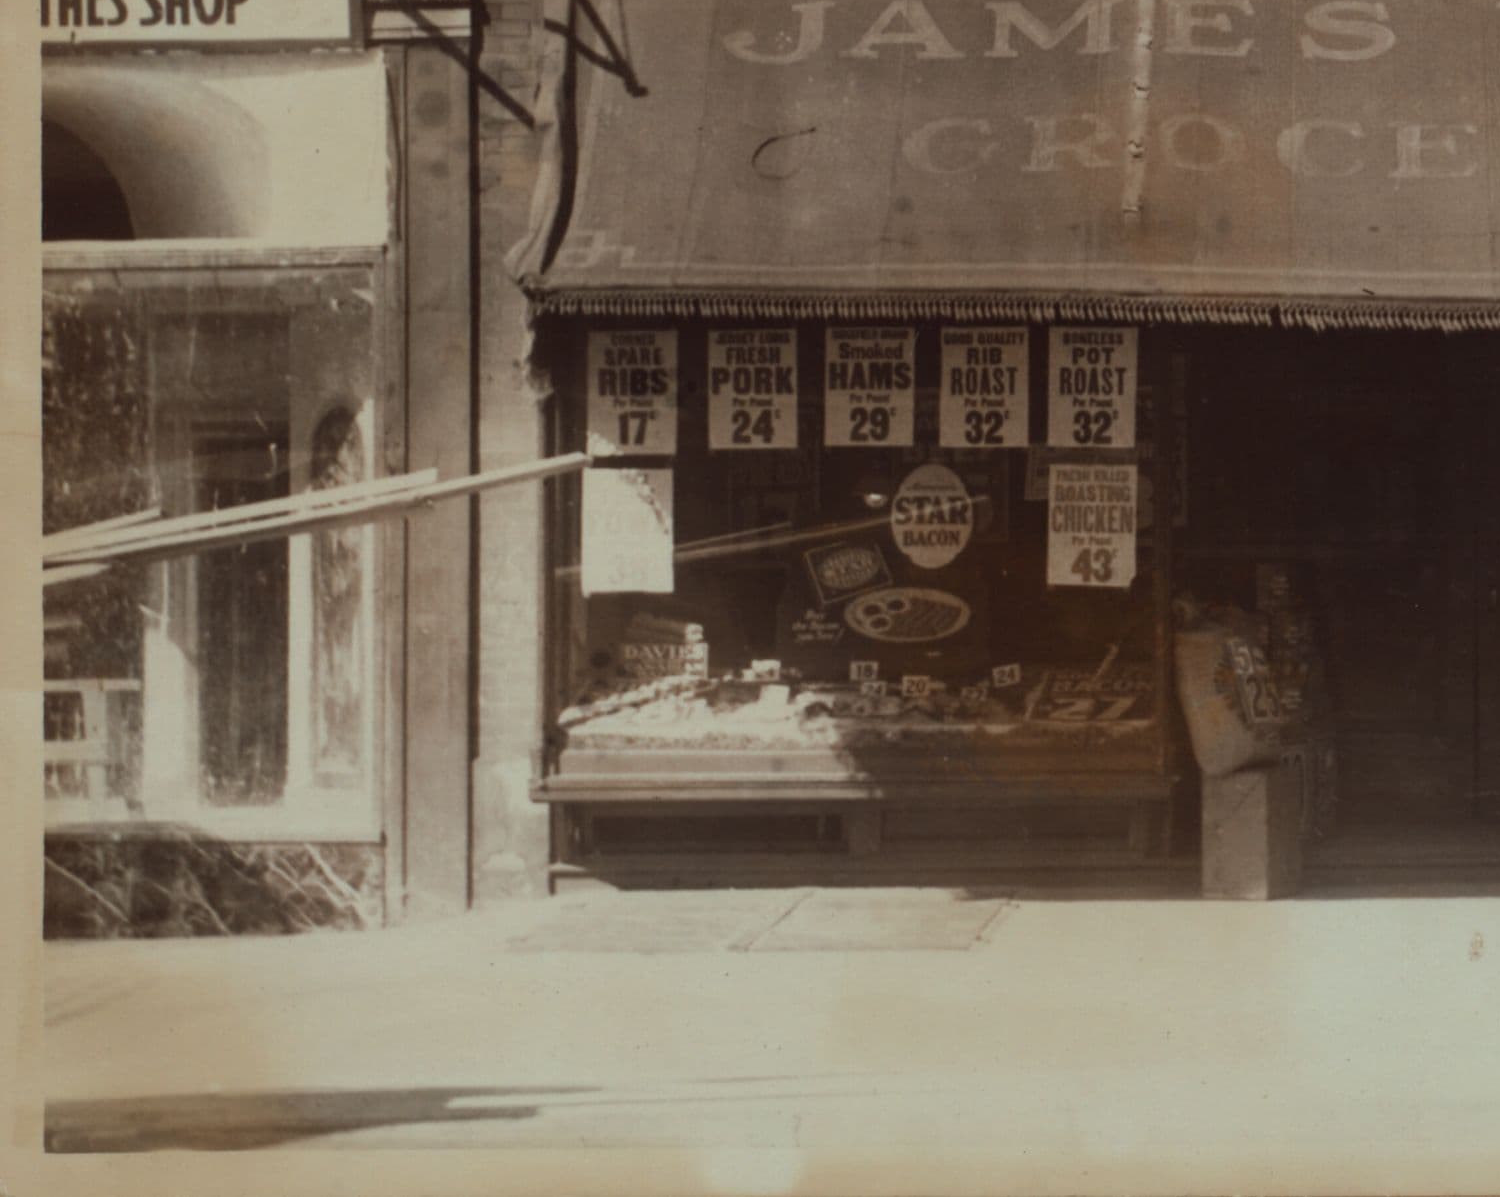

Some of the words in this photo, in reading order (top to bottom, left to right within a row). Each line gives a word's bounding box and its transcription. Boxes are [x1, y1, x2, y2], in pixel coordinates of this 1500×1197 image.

[977, 332, 1025, 345] QUALITY
[604, 346, 664, 366] SPARE
[725, 346, 781, 365] FRESH
[838, 341, 904, 360] Smoked
[966, 346, 1003, 365] RIB
[1071, 347, 1115, 366] POT
[598, 367, 669, 396] RIBS
[711, 366, 795, 395] PORK
[828, 361, 912, 391] HAMS
[950, 366, 1018, 396] ROAST
[1059, 366, 1127, 396] ROAST
[1055, 484, 1131, 503] ROASTING
[895, 495, 971, 525] STAR
[1051, 505, 1134, 534] CHICKEN
[902, 530, 961, 547] BACON
